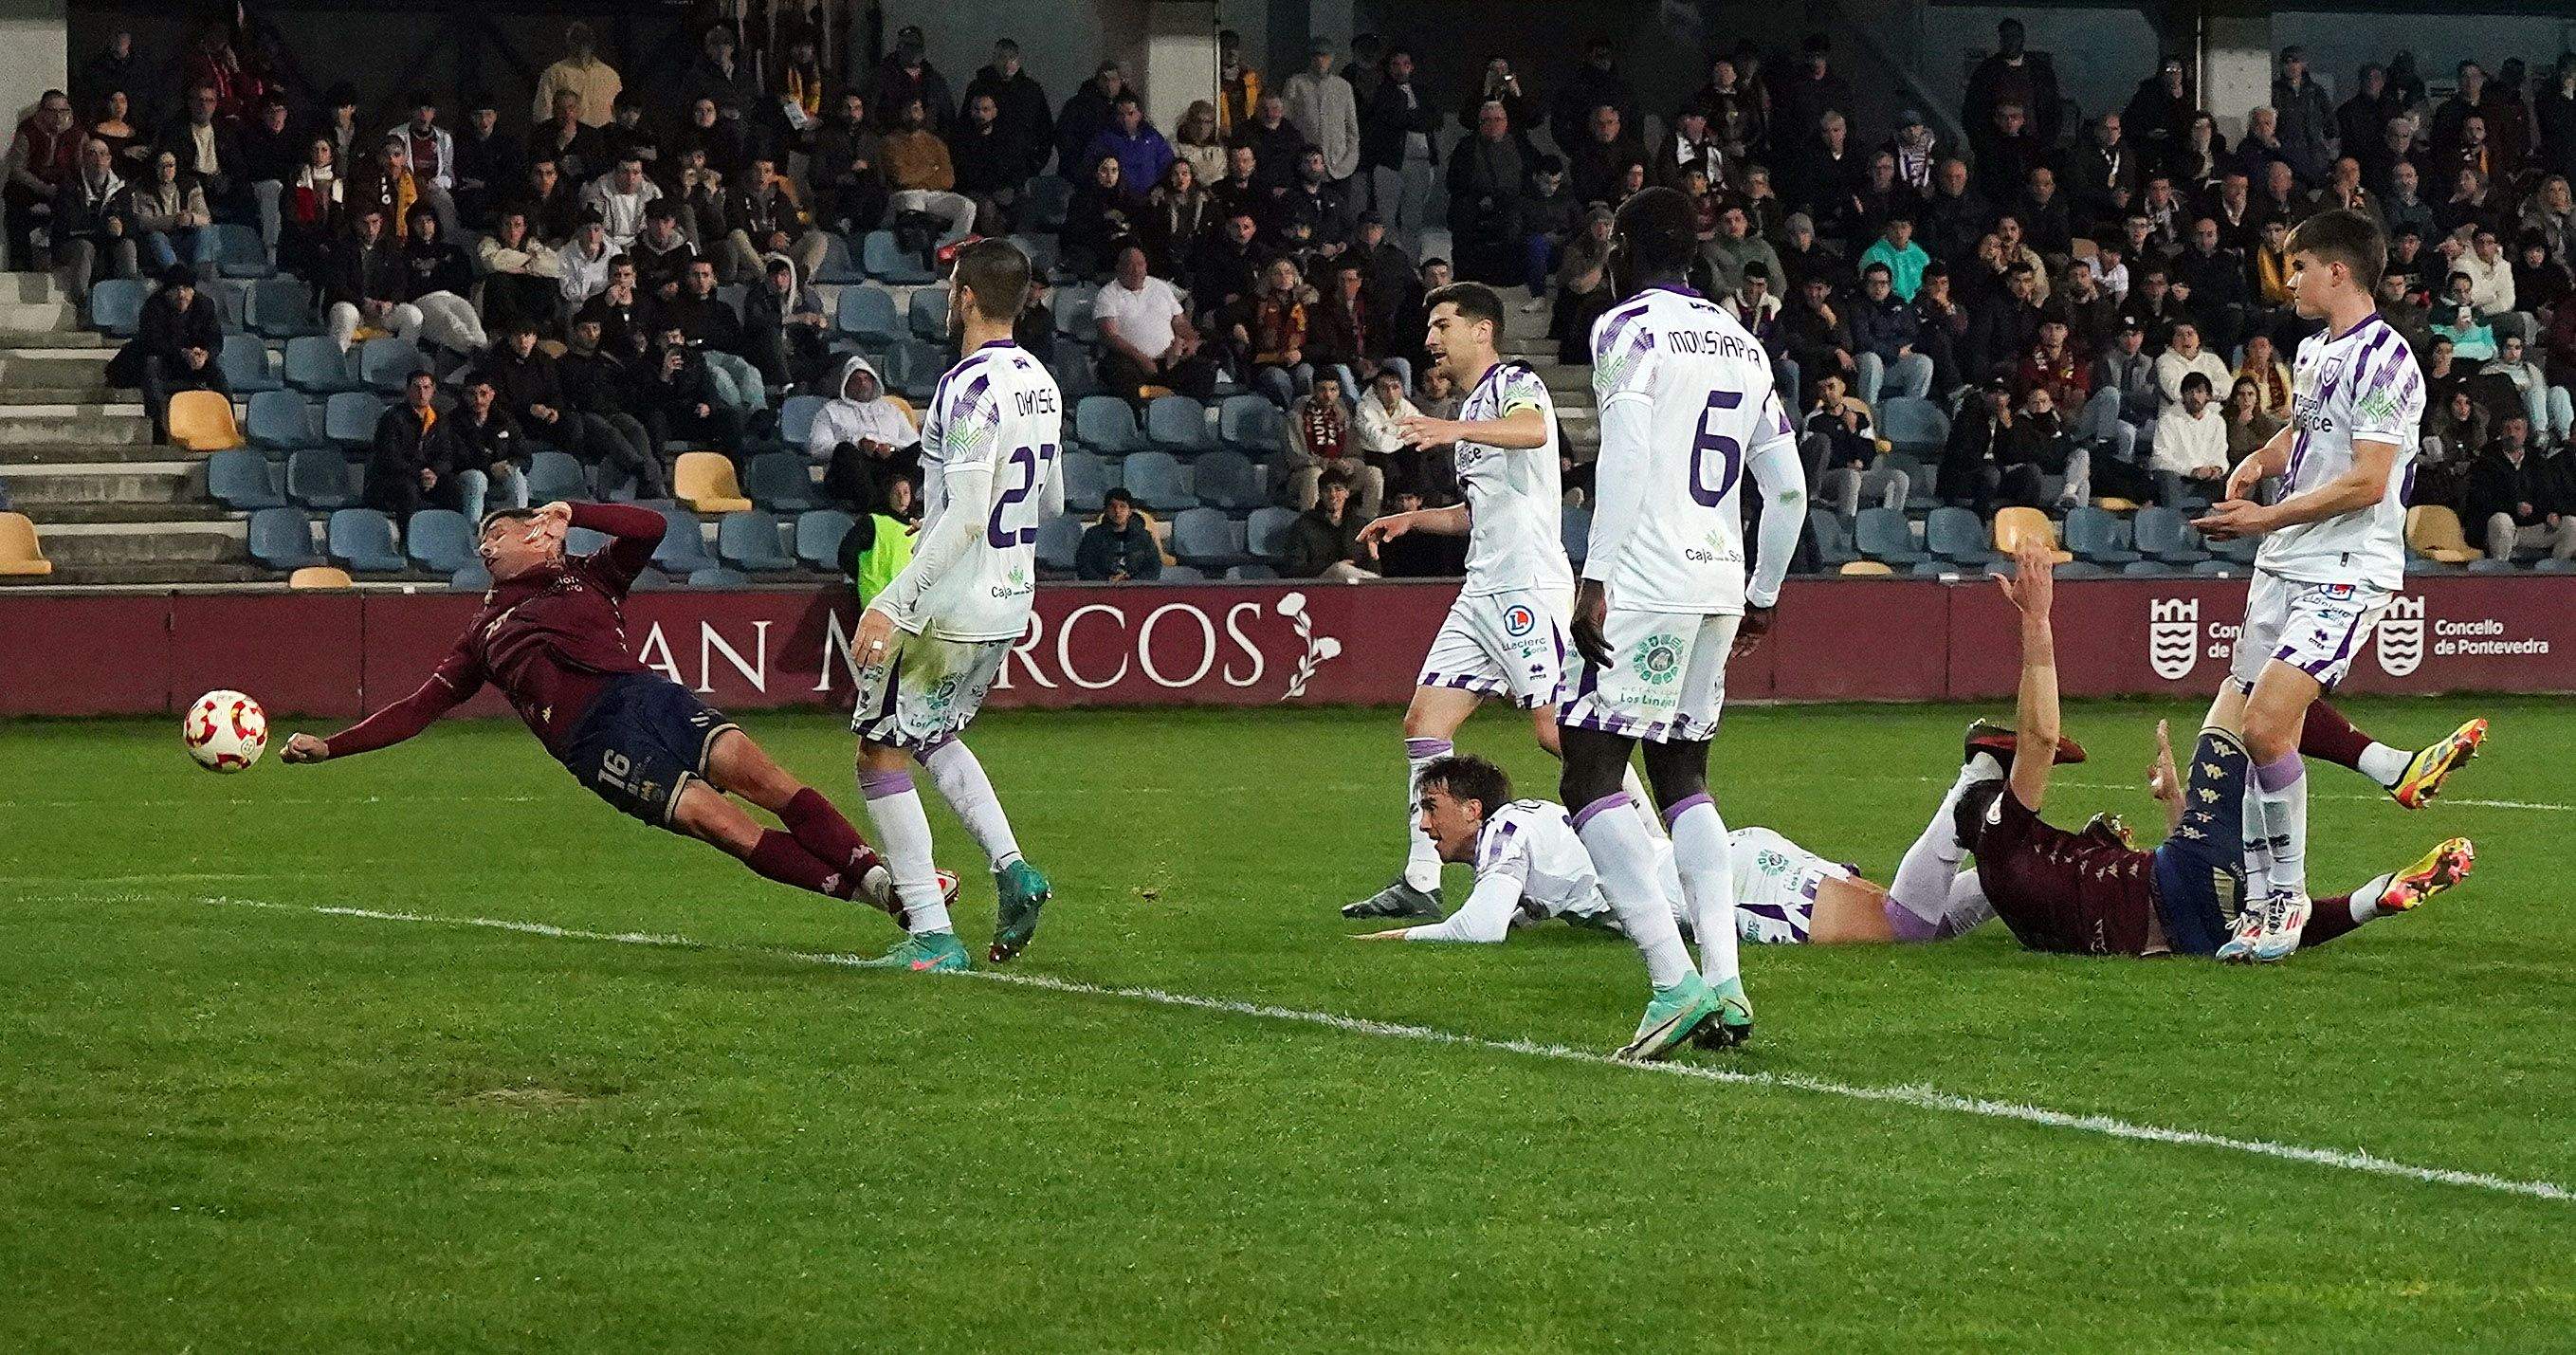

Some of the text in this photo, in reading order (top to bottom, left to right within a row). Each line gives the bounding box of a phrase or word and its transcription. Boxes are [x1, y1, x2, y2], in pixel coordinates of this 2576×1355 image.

[1689, 391, 1744, 508] 6
[1685, 548, 1713, 564] Caja
[991, 585, 1013, 599] Caja
[2208, 622, 2240, 639] Con
[2435, 619, 2504, 635] Concello
[639, 600, 1266, 694] AN MRCOS
[2208, 642, 2230, 658] de
[2434, 637, 2549, 655] de Pontevedra
[597, 748, 630, 791] 16
